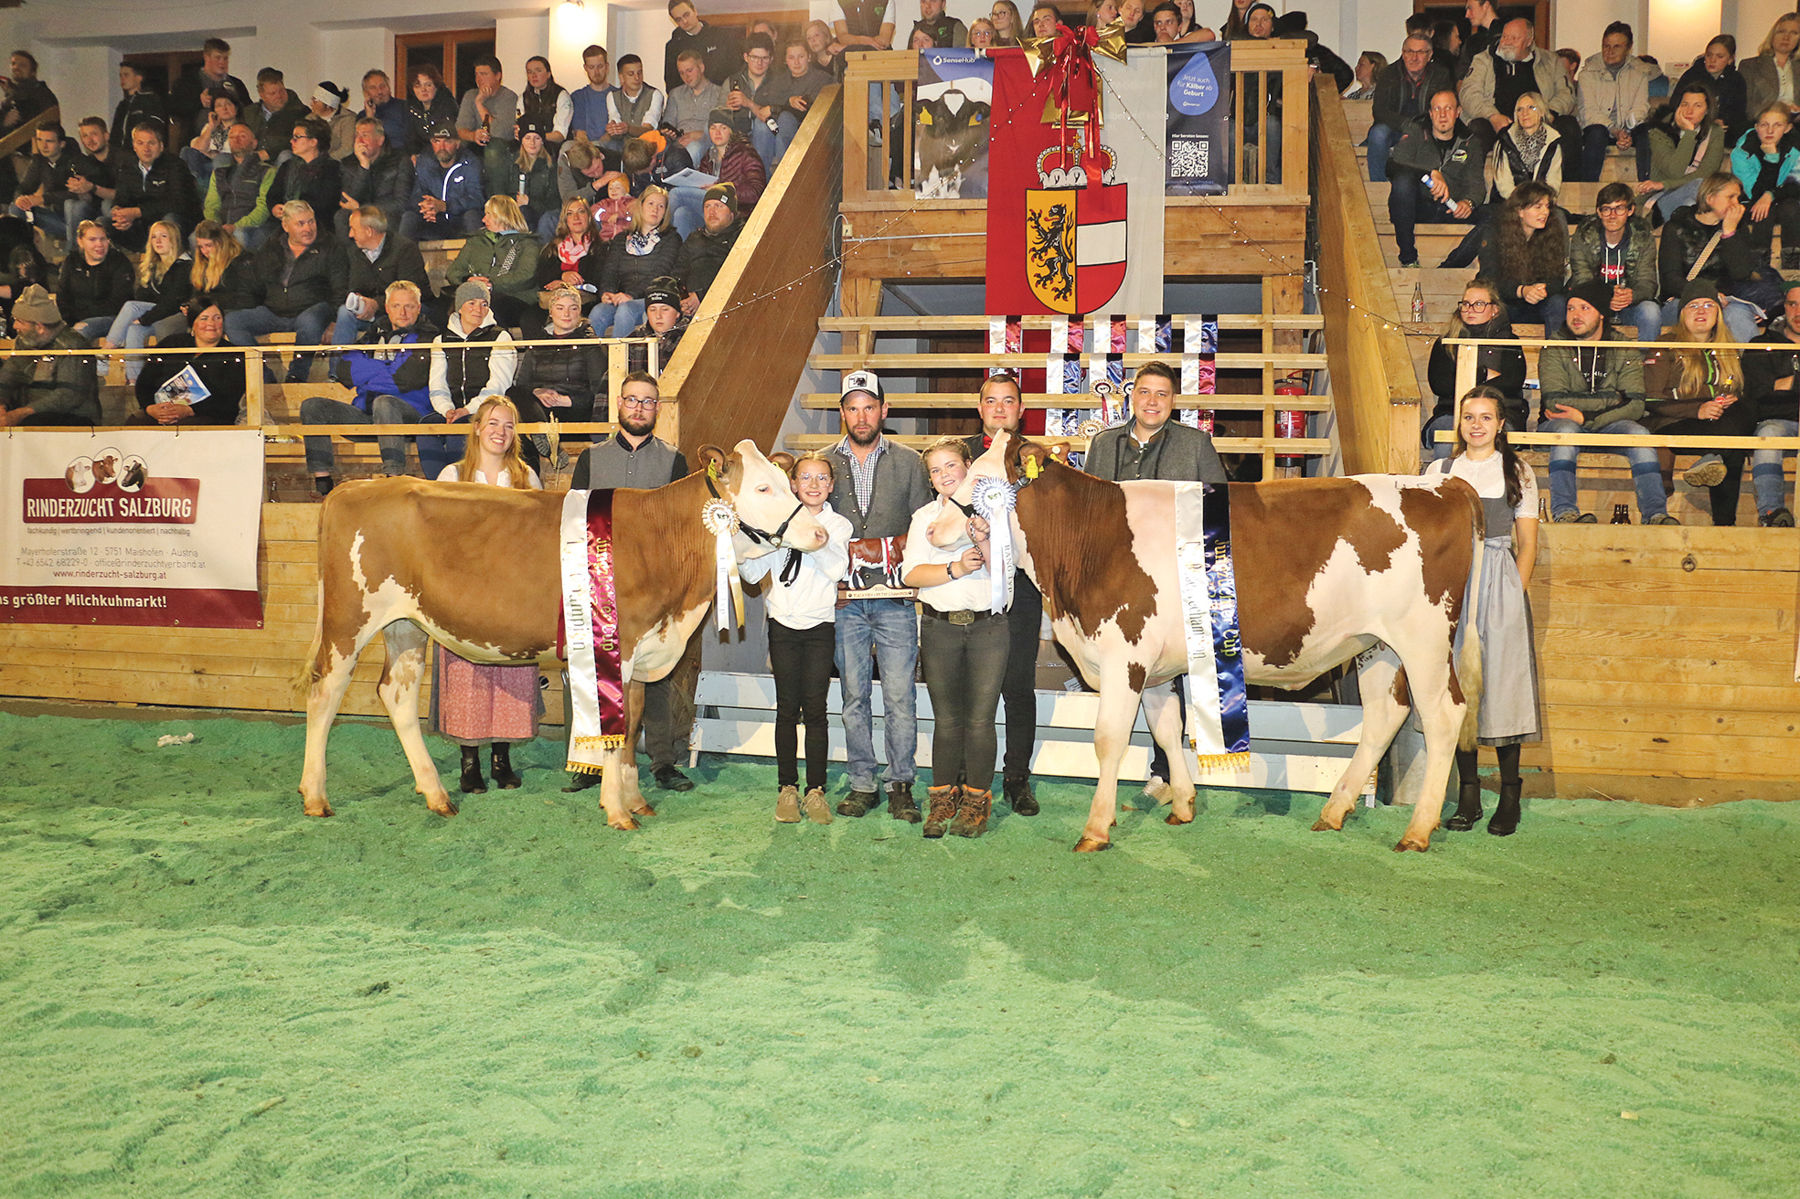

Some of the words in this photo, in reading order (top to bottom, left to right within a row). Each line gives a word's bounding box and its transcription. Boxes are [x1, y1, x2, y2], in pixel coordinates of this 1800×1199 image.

[1186, 82, 1205, 90] Kälber
[27, 498, 114, 517] RINDERZUCHT
[119, 498, 192, 518] SALZBURG
[90, 547, 98, 556] 12
[105, 547, 121, 556] 5751
[171, 547, 199, 557] Austria
[53, 570, 167, 580] www.rinderzucht-salzburg.at
[13, 593, 61, 608] größter
[65, 593, 168, 608] Milchkuhmarkt!
[1220, 628, 1241, 657] Cup
